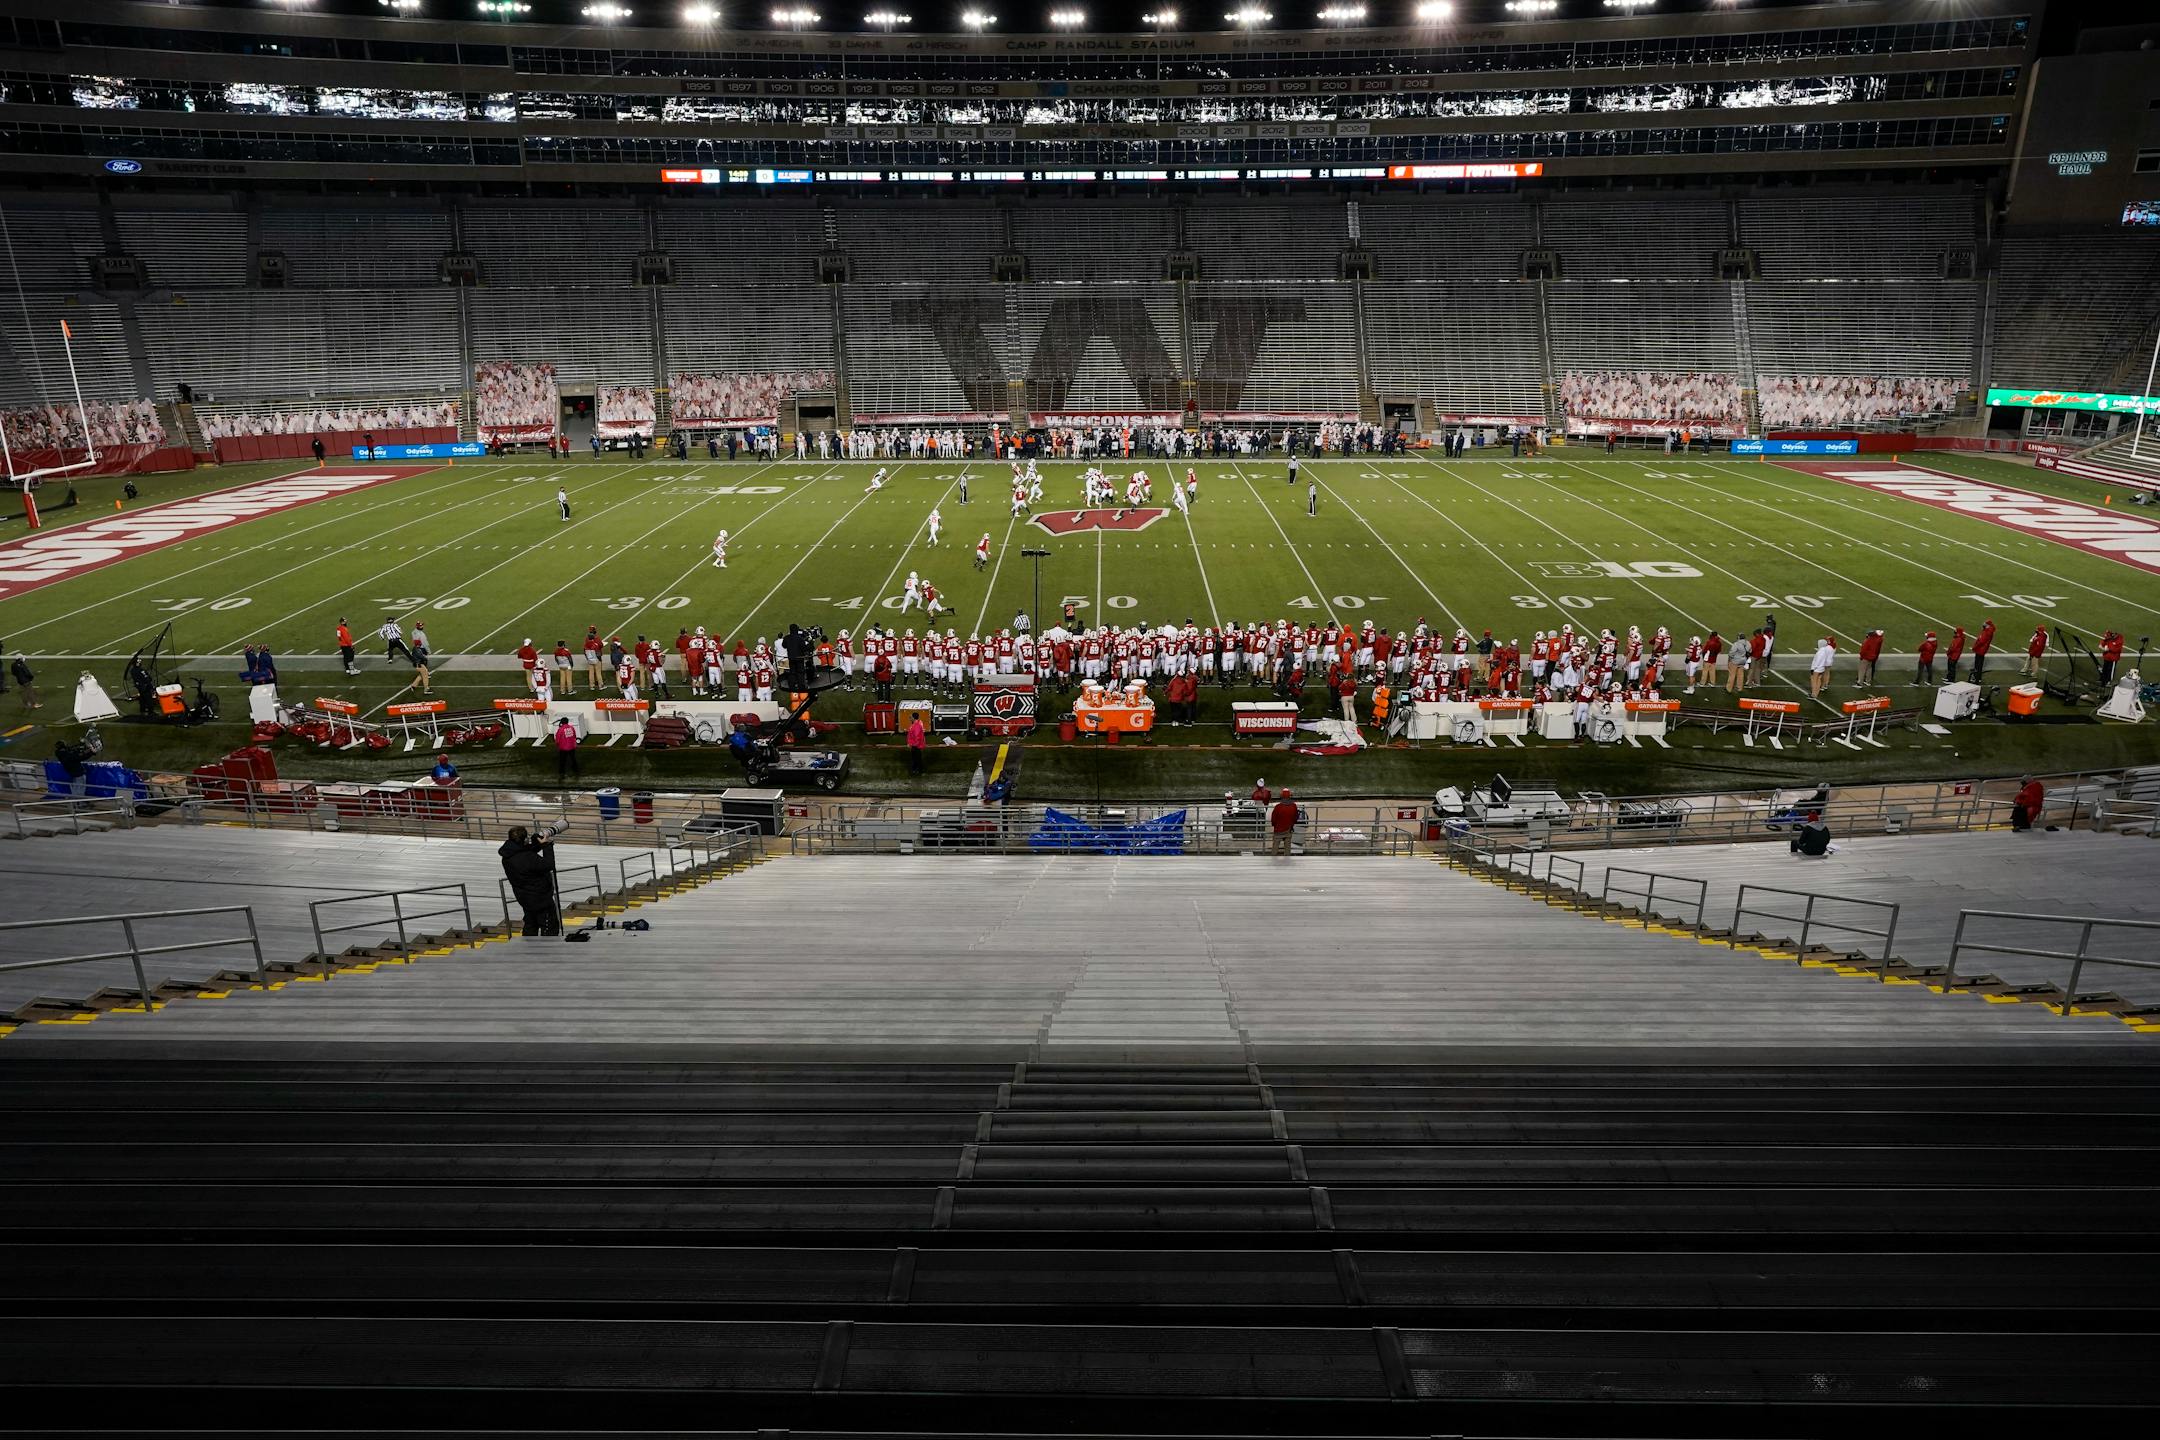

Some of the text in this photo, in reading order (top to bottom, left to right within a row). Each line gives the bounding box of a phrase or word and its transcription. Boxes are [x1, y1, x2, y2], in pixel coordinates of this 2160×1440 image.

[1006, 40, 1196, 50] CAMP RANDALL STADIUM
[686, 81, 711, 92] 1896
[727, 81, 752, 92] 1897
[770, 83, 793, 93] 1901
[809, 83, 835, 93] 1906
[891, 83, 915, 93] 1952
[1241, 82, 1267, 92] 1998
[1282, 81, 1307, 91] 1999
[1322, 80, 1349, 90] 2010
[1364, 80, 1388, 90] 2011
[1404, 78, 1430, 88] 2012
[851, 84, 873, 93] 1912
[931, 84, 956, 93] 1959
[969, 84, 994, 94] 1962
[1073, 84, 1161, 94] CHAMPIONS
[1201, 84, 1226, 94] 1993
[829, 128, 854, 138] 1953
[868, 128, 895, 138] 1960
[909, 128, 933, 138] 1963
[948, 128, 973, 138] 1994
[988, 128, 1012, 138] 1999
[1109, 127, 1152, 137] BOWL
[1179, 126, 1207, 136] 2000
[1223, 126, 1245, 136] 2011
[1261, 125, 1286, 134] 2012
[1301, 124, 1325, 134] 2013
[1340, 124, 1367, 133] 2020
[2048, 151, 2108, 164] KELLNER
[1465, 164, 1518, 177] FOOTBALL
[2058, 163, 2093, 175] HALL
[1044, 415, 1167, 426] WISCONSIN
[406, 447, 434, 455] Odyssey
[451, 446, 480, 454] Odyssey
[1737, 443, 1764, 451] Odyssey
[1781, 443, 1808, 451] Odyssey
[1825, 443, 1852, 451] Odyssey
[1822, 471, 2160, 567] WISCON
[0, 474, 398, 592] SCONSIN
[156, 597, 253, 612] 10
[378, 597, 472, 611] 20
[606, 596, 692, 609] 30
[832, 596, 909, 609] 40
[1060, 596, 1139, 609] 50
[1286, 595, 1366, 609] 40
[1509, 596, 1595, 609] 30
[1735, 594, 1826, 608] 20
[1958, 594, 2057, 608] 10
[399, 705, 432, 713] GATORADE
[994, 695, 1016, 715] W
[1752, 702, 1787, 710] GATORADE
[1129, 712, 1144, 727] G
[1238, 717, 1294, 728] WISCONSIN
